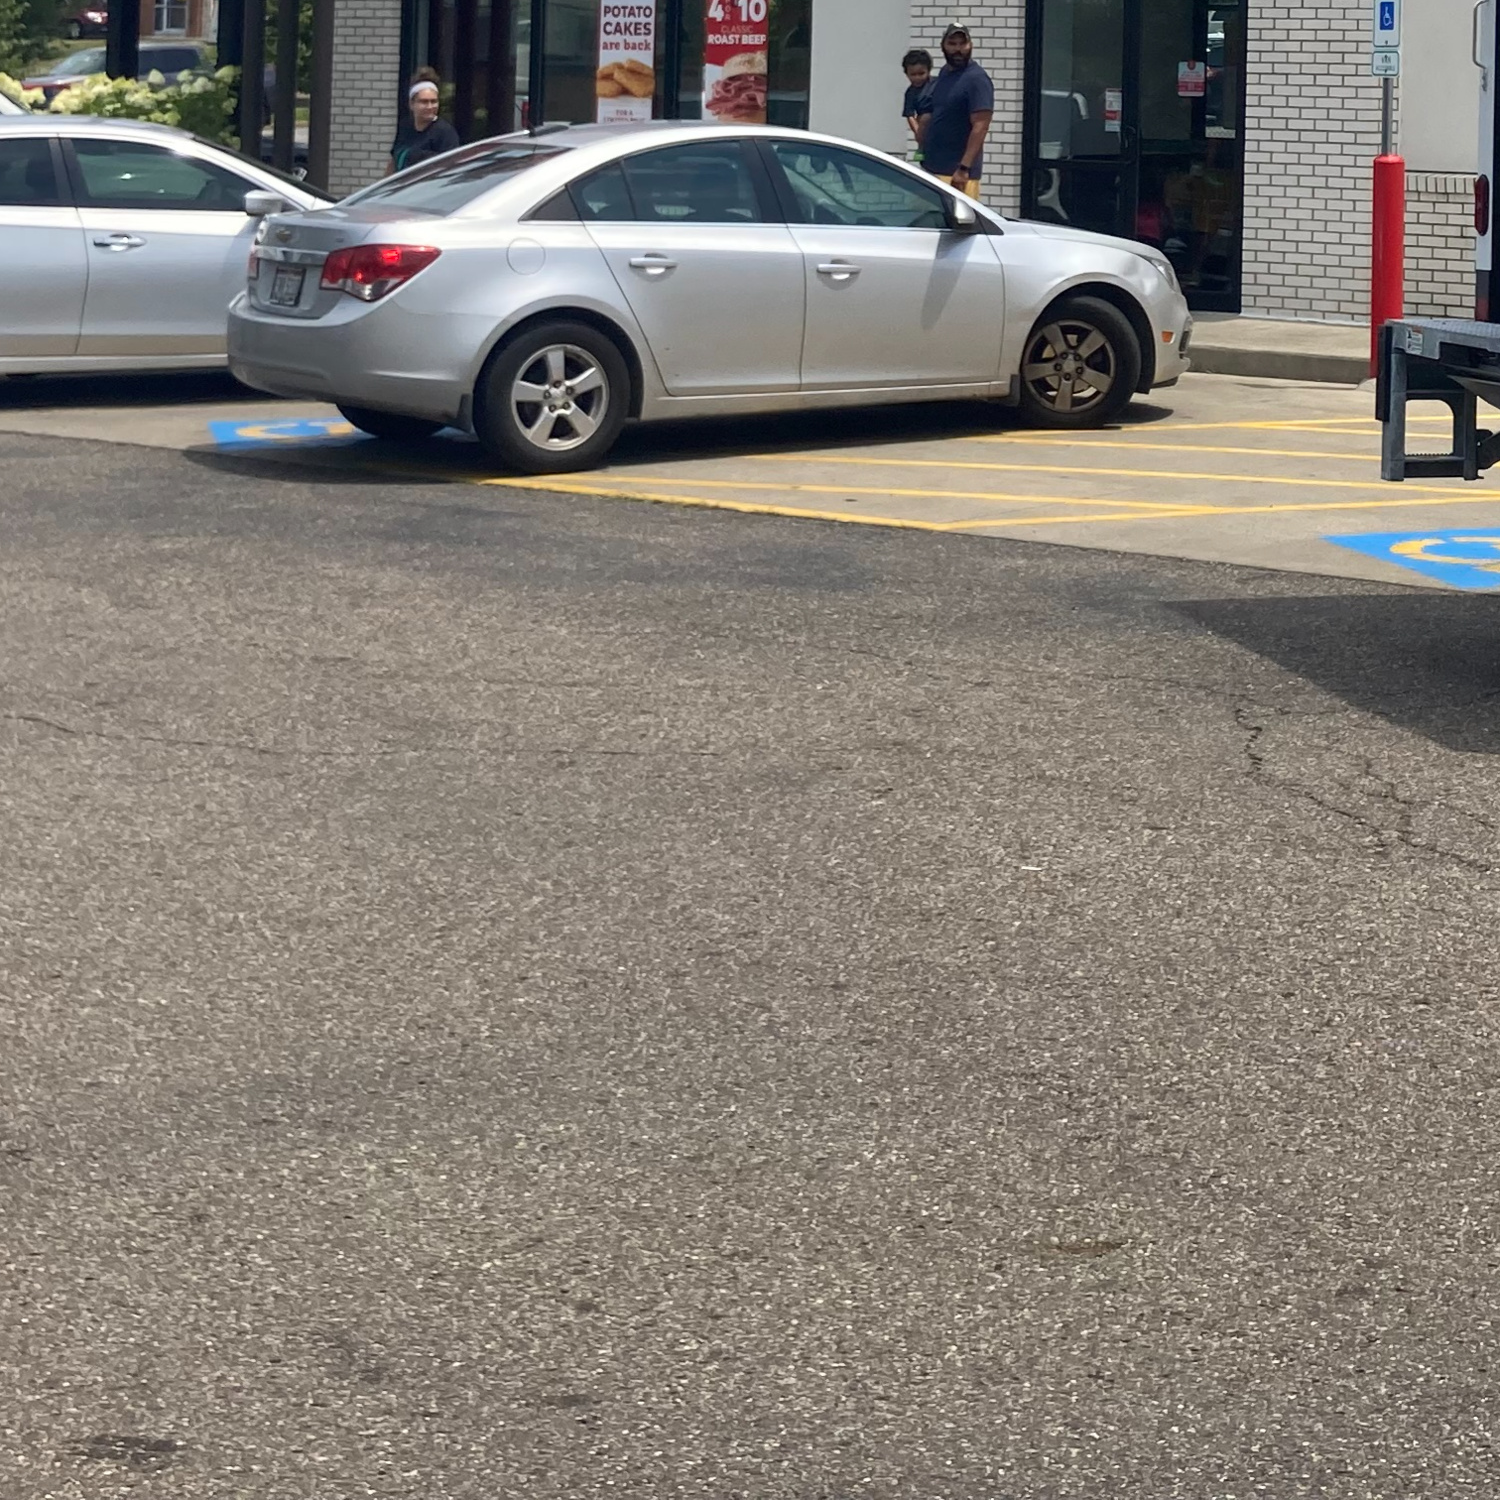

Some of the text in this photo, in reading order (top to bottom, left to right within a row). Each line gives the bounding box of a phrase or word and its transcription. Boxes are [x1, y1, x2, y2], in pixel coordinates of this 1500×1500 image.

[604, 5, 653, 18] POTATO
[603, 21, 652, 36] CAKES
[602, 38, 651, 51] are back
[708, 34, 766, 45] ROAST BEEF
